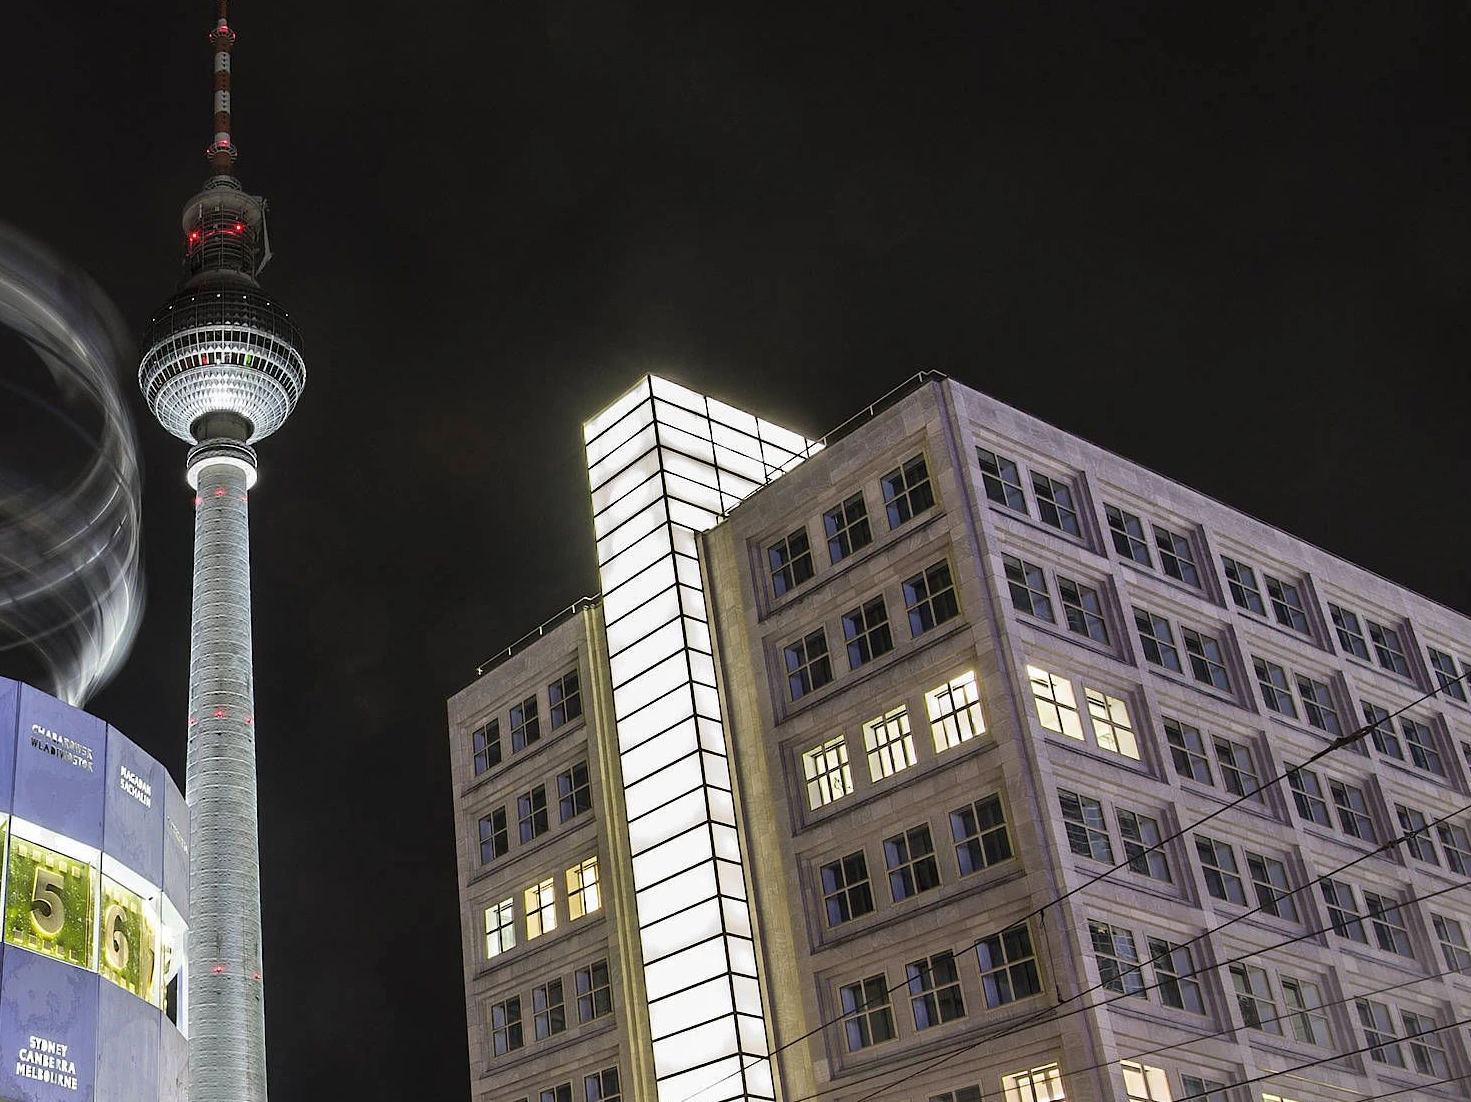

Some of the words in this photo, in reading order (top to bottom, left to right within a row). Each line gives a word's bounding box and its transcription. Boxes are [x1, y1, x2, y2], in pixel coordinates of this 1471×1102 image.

[30, 867, 64, 936] 5
[105, 904, 129, 970] 6
[30, 1035, 68, 1057] SYDNEY
[19, 1048, 77, 1075] CANBERRA
[15, 1062, 78, 1090] MELBOURNE
